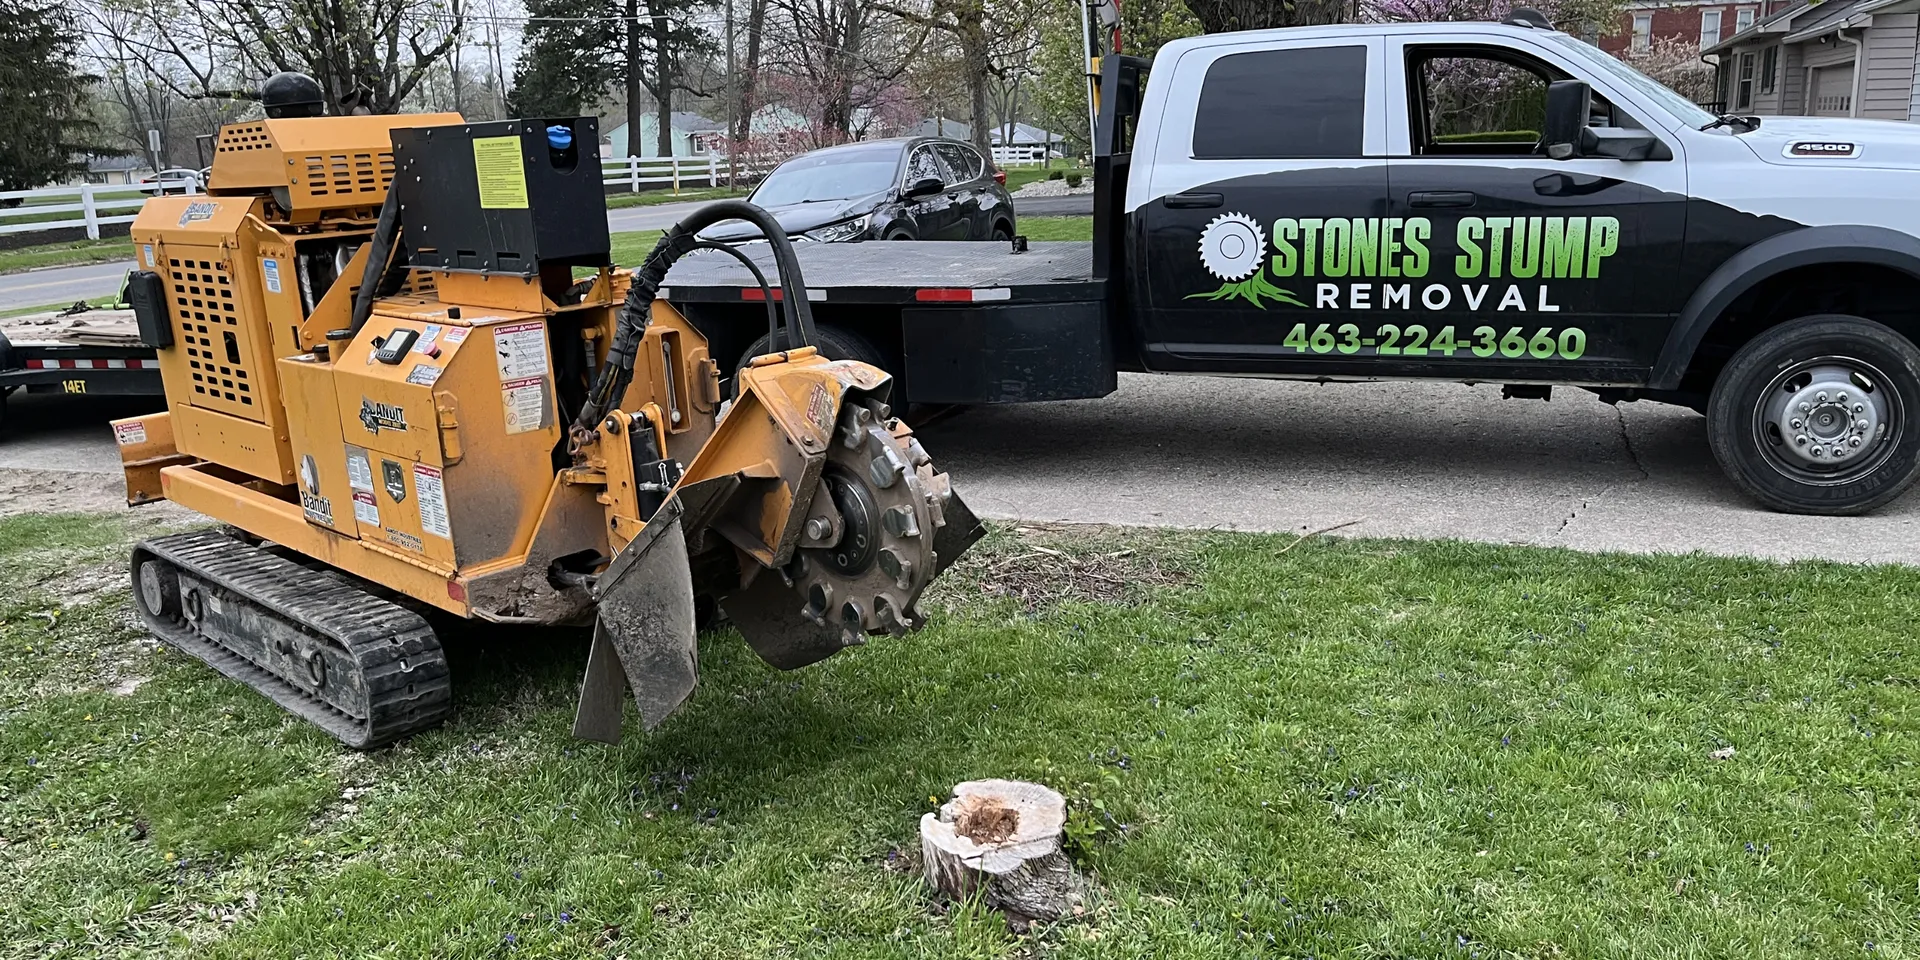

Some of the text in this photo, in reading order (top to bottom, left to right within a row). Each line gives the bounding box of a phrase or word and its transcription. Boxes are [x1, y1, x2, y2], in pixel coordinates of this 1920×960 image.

[1797, 143, 1851, 151] 4500
[1272, 216, 1620, 279] STONES STUMP
[1316, 283, 1560, 312] REMOVAL
[1282, 323, 1587, 361] 463-224-3660
[62, 380, 87, 393] 14ET
[301, 491, 332, 517] Bandit
